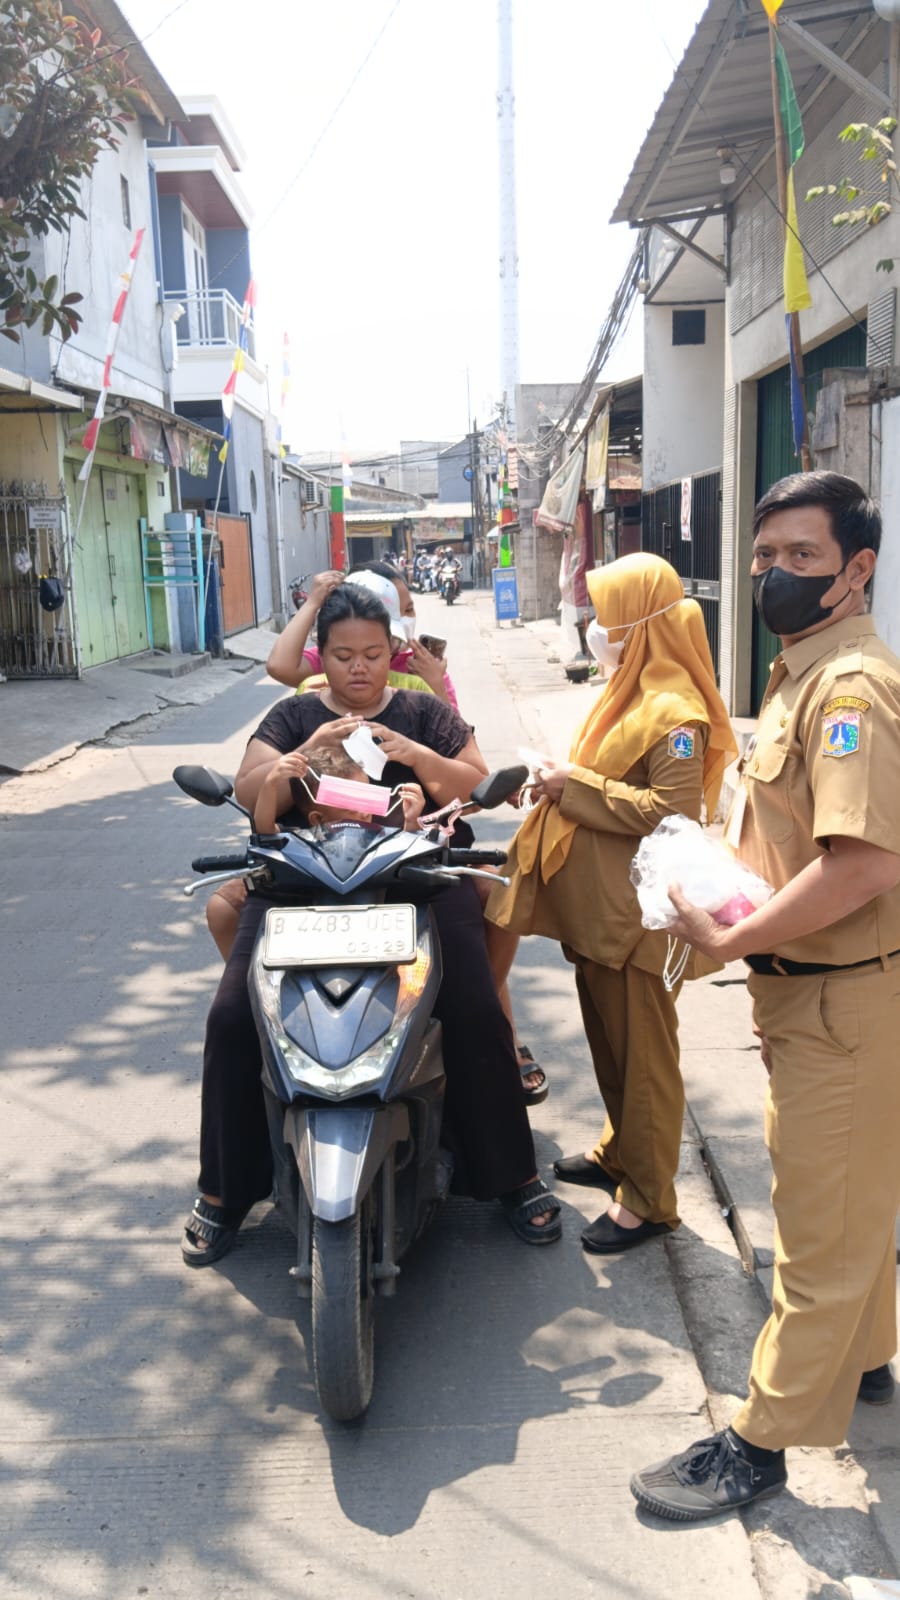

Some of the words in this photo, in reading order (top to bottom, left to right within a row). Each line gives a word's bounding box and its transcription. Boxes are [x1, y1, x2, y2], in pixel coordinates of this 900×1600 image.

[331, 821, 360, 829] HONDA
[274, 917, 286, 935] B
[297, 914, 351, 933] 4483
